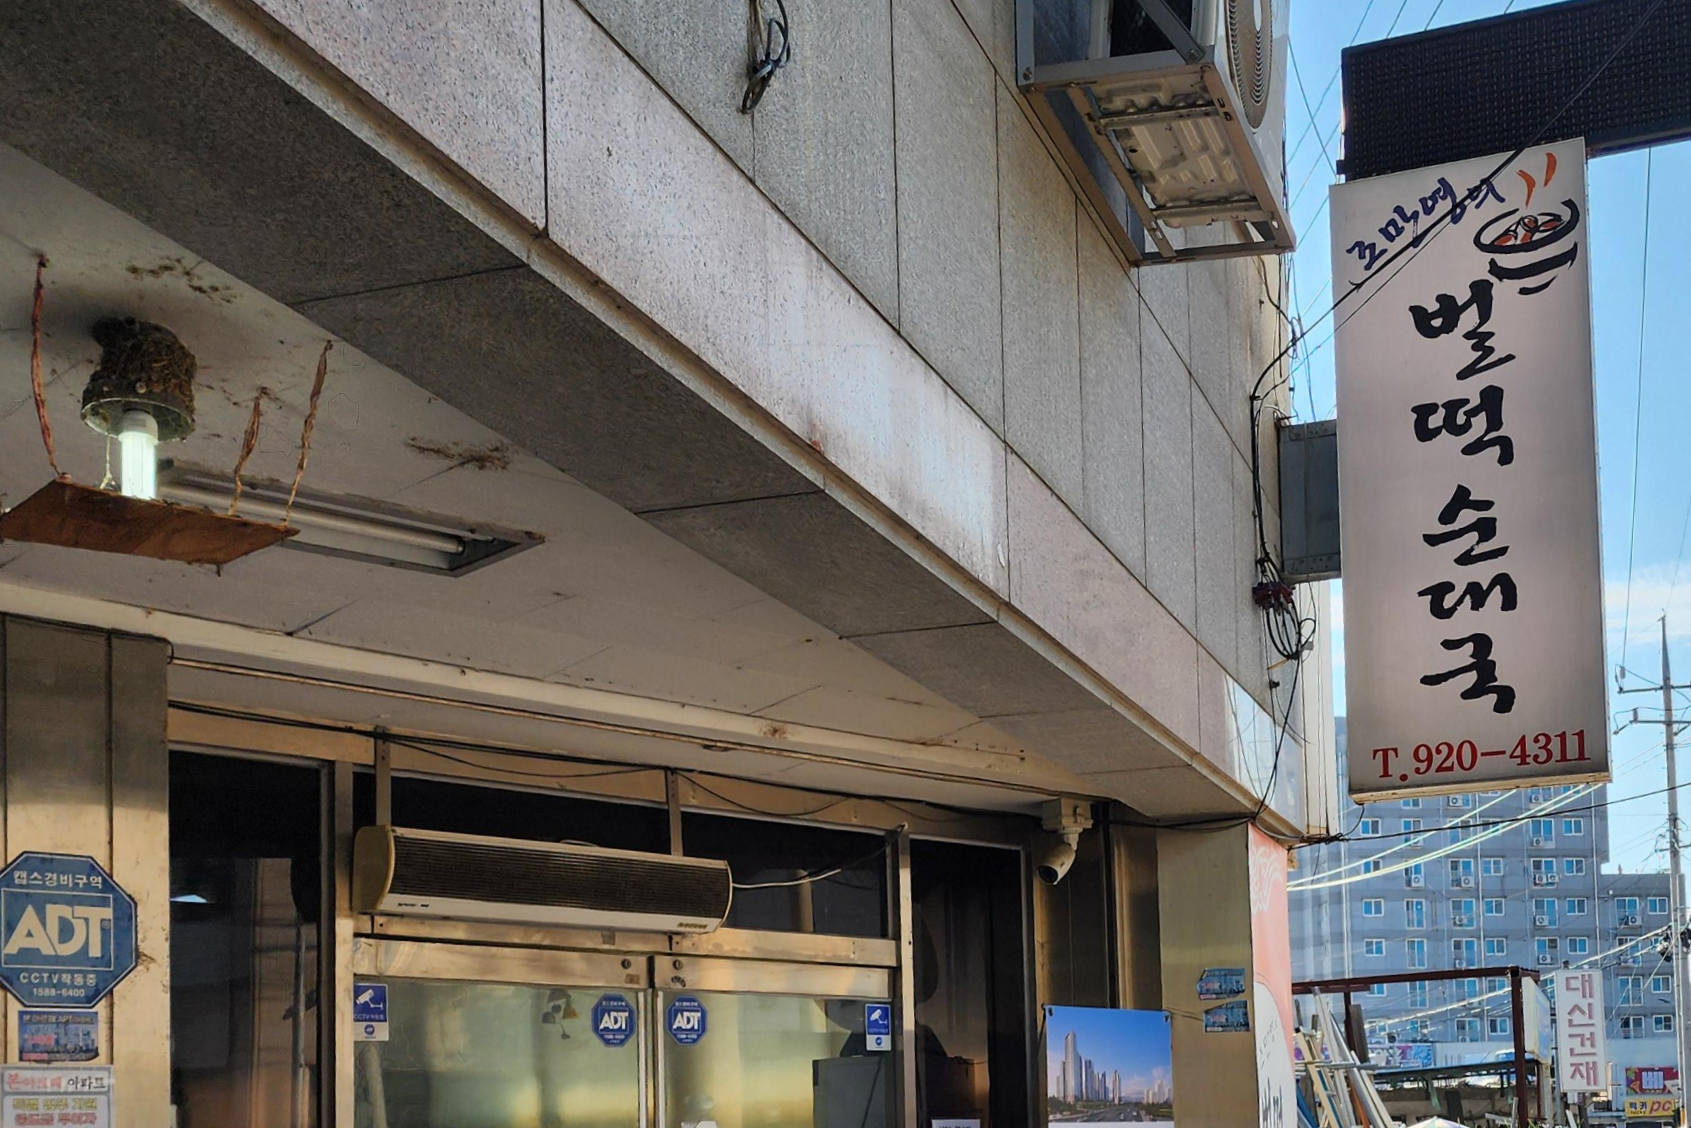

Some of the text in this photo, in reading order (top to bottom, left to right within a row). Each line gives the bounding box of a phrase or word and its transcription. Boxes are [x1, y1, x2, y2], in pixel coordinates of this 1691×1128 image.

[1408, 279, 1517, 714] 벌떡순대국
[1372, 728, 1591, 782] T.920-4311
[14, 870, 103, 889] 캡스경비구역
[4, 904, 111, 957] ADT
[20, 972, 97, 986] CCTV작동중
[33, 989, 85, 998] 1588-6400
[599, 1011, 629, 1030] ADT
[673, 1011, 701, 1030] ADT
[1565, 973, 1598, 1087] 대신건재
[67, 1076, 106, 1090] 아파트
